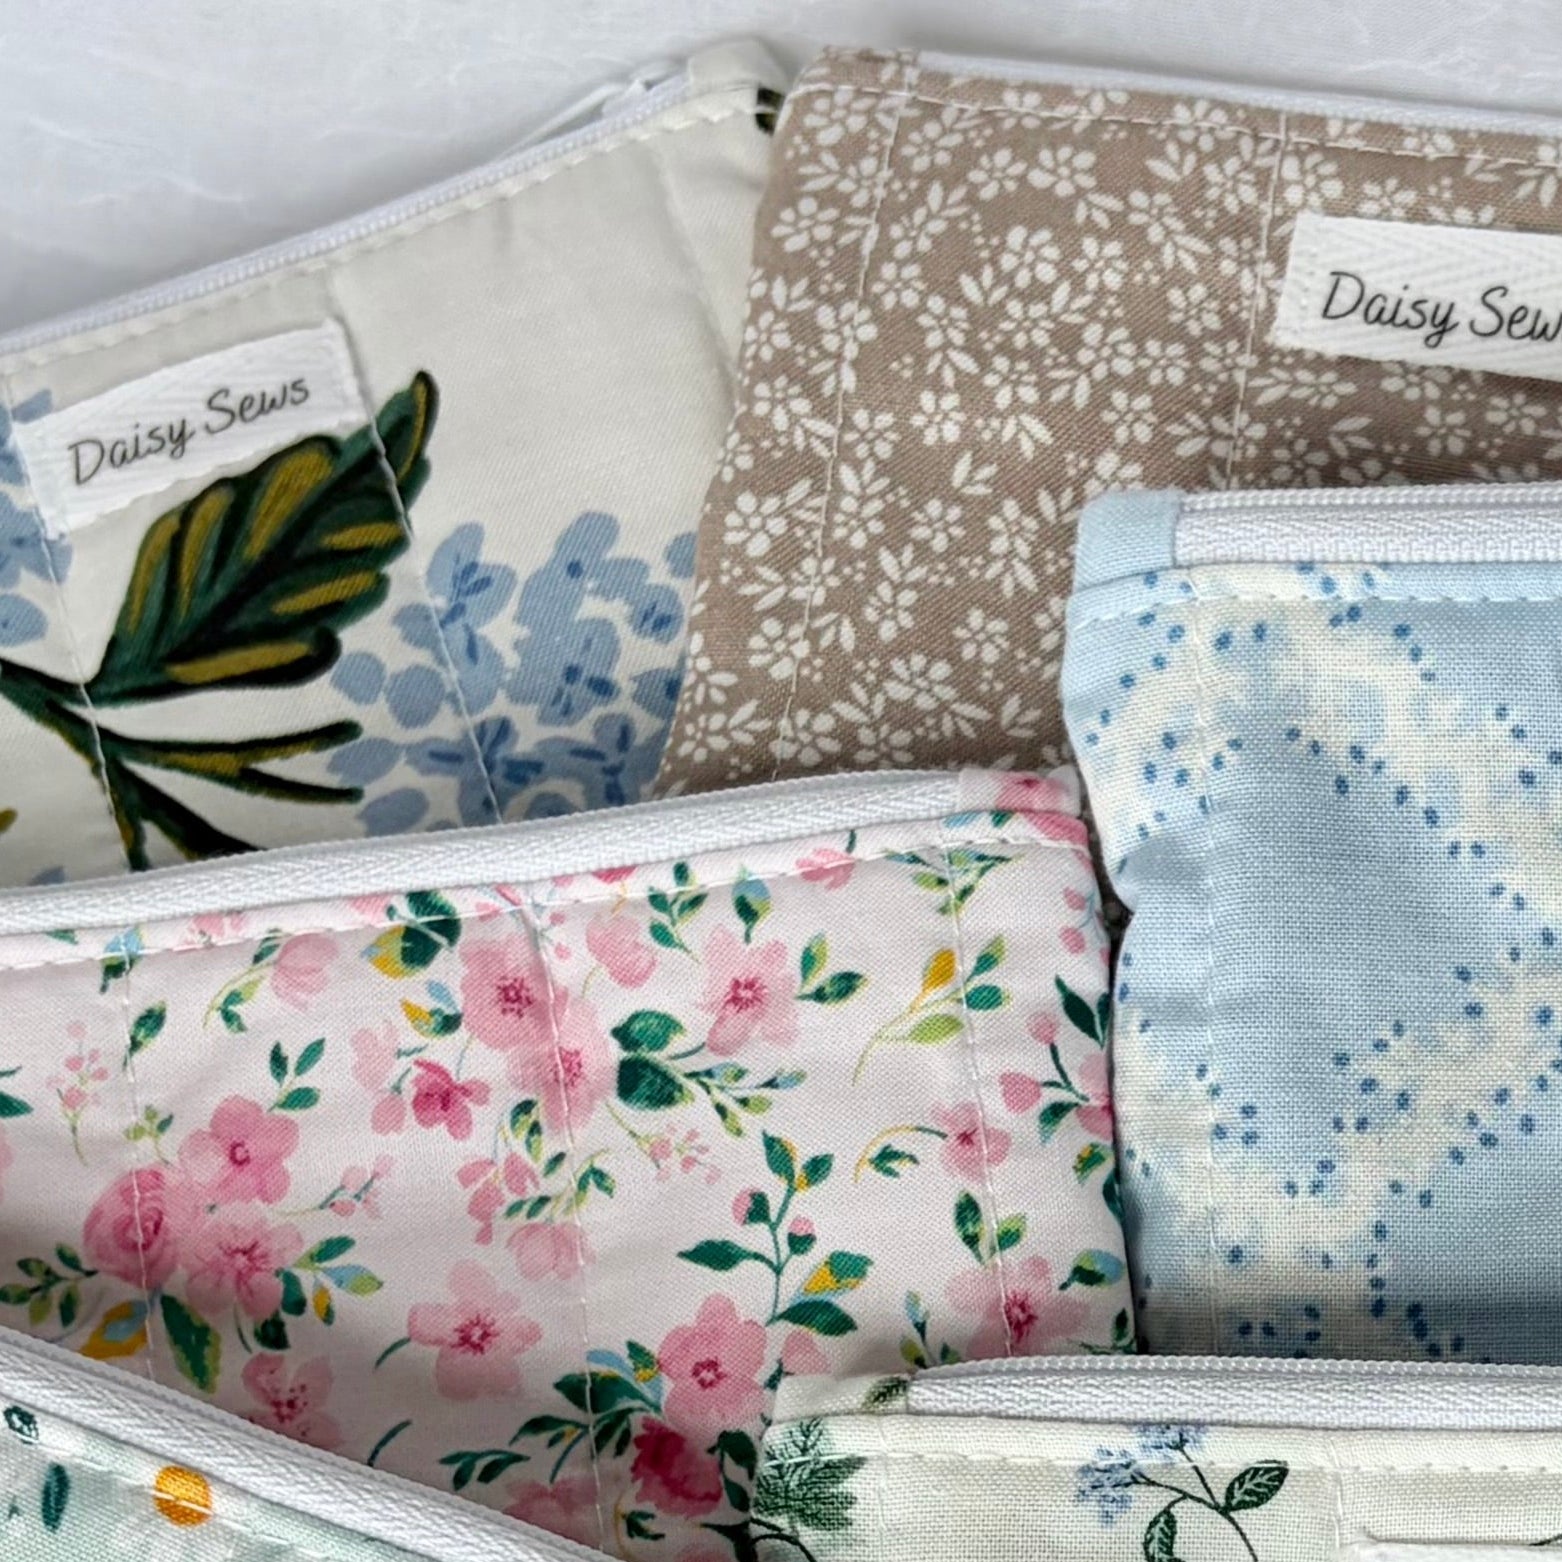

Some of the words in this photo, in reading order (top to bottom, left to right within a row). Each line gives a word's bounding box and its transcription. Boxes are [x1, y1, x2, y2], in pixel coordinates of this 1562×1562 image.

[1322, 271, 1459, 348] Daisy
[68, 418, 196, 484] Daisy
[204, 378, 309, 434] Sews
